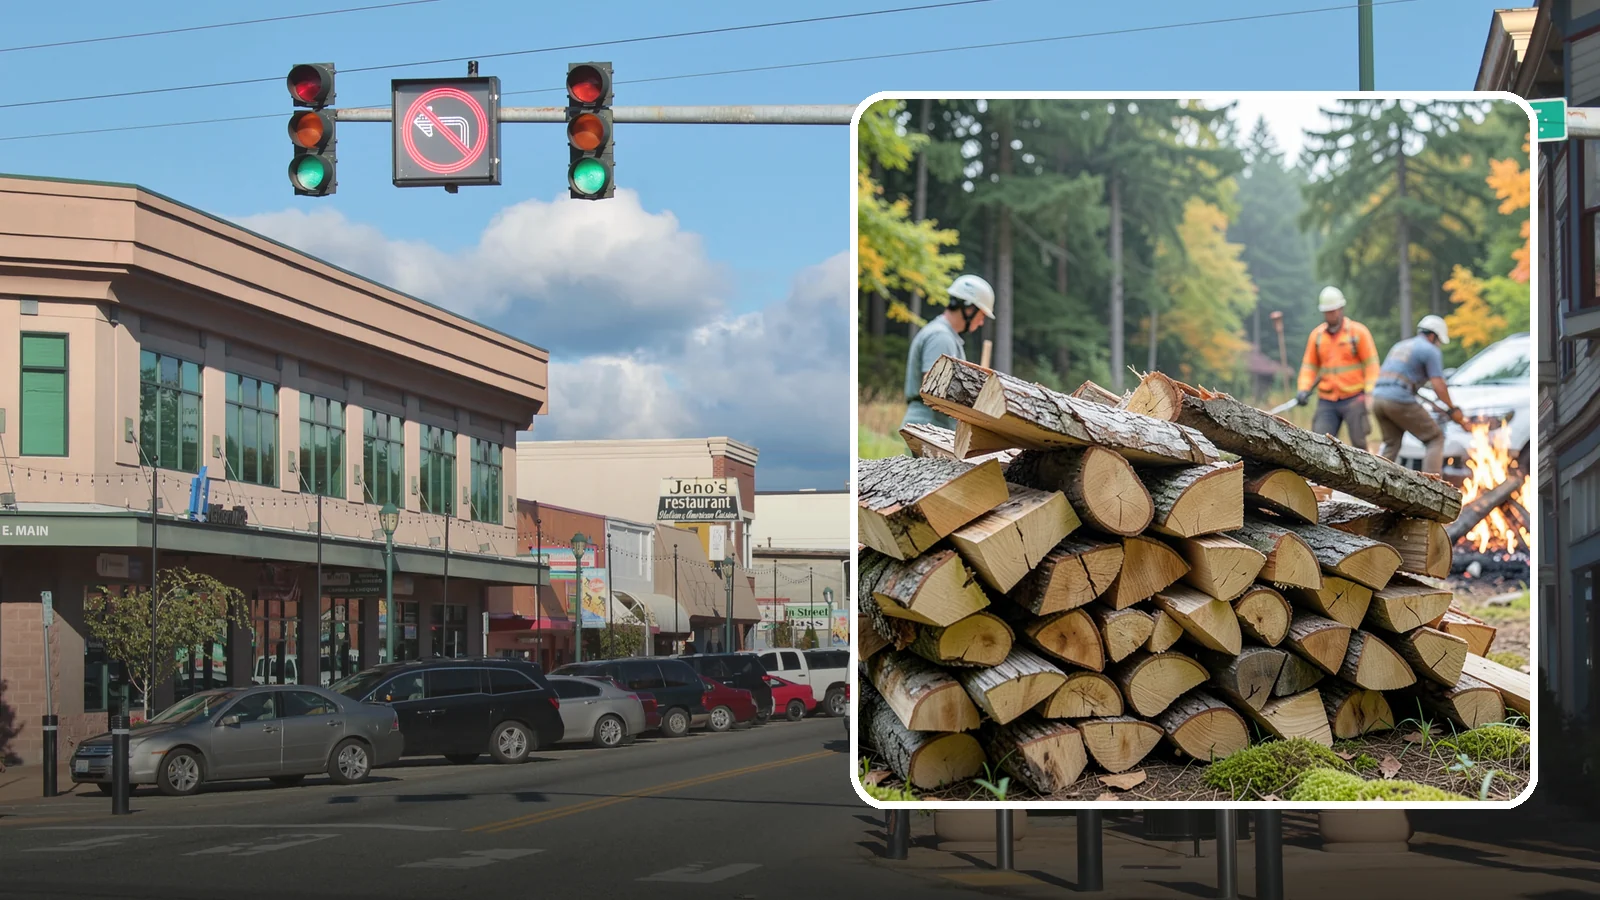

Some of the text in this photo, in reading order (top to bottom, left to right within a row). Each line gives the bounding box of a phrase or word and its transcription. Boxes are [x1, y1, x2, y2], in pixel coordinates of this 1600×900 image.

[669, 480, 728, 494] Jeno's
[665, 497, 731, 509] restaurant
[659, 510, 682, 519] Italian
[686, 510, 714, 519] American
[715, 510, 738, 519] Cuisine
[2, 525, 49, 536] E. MAIN
[797, 607, 828, 617] Street
